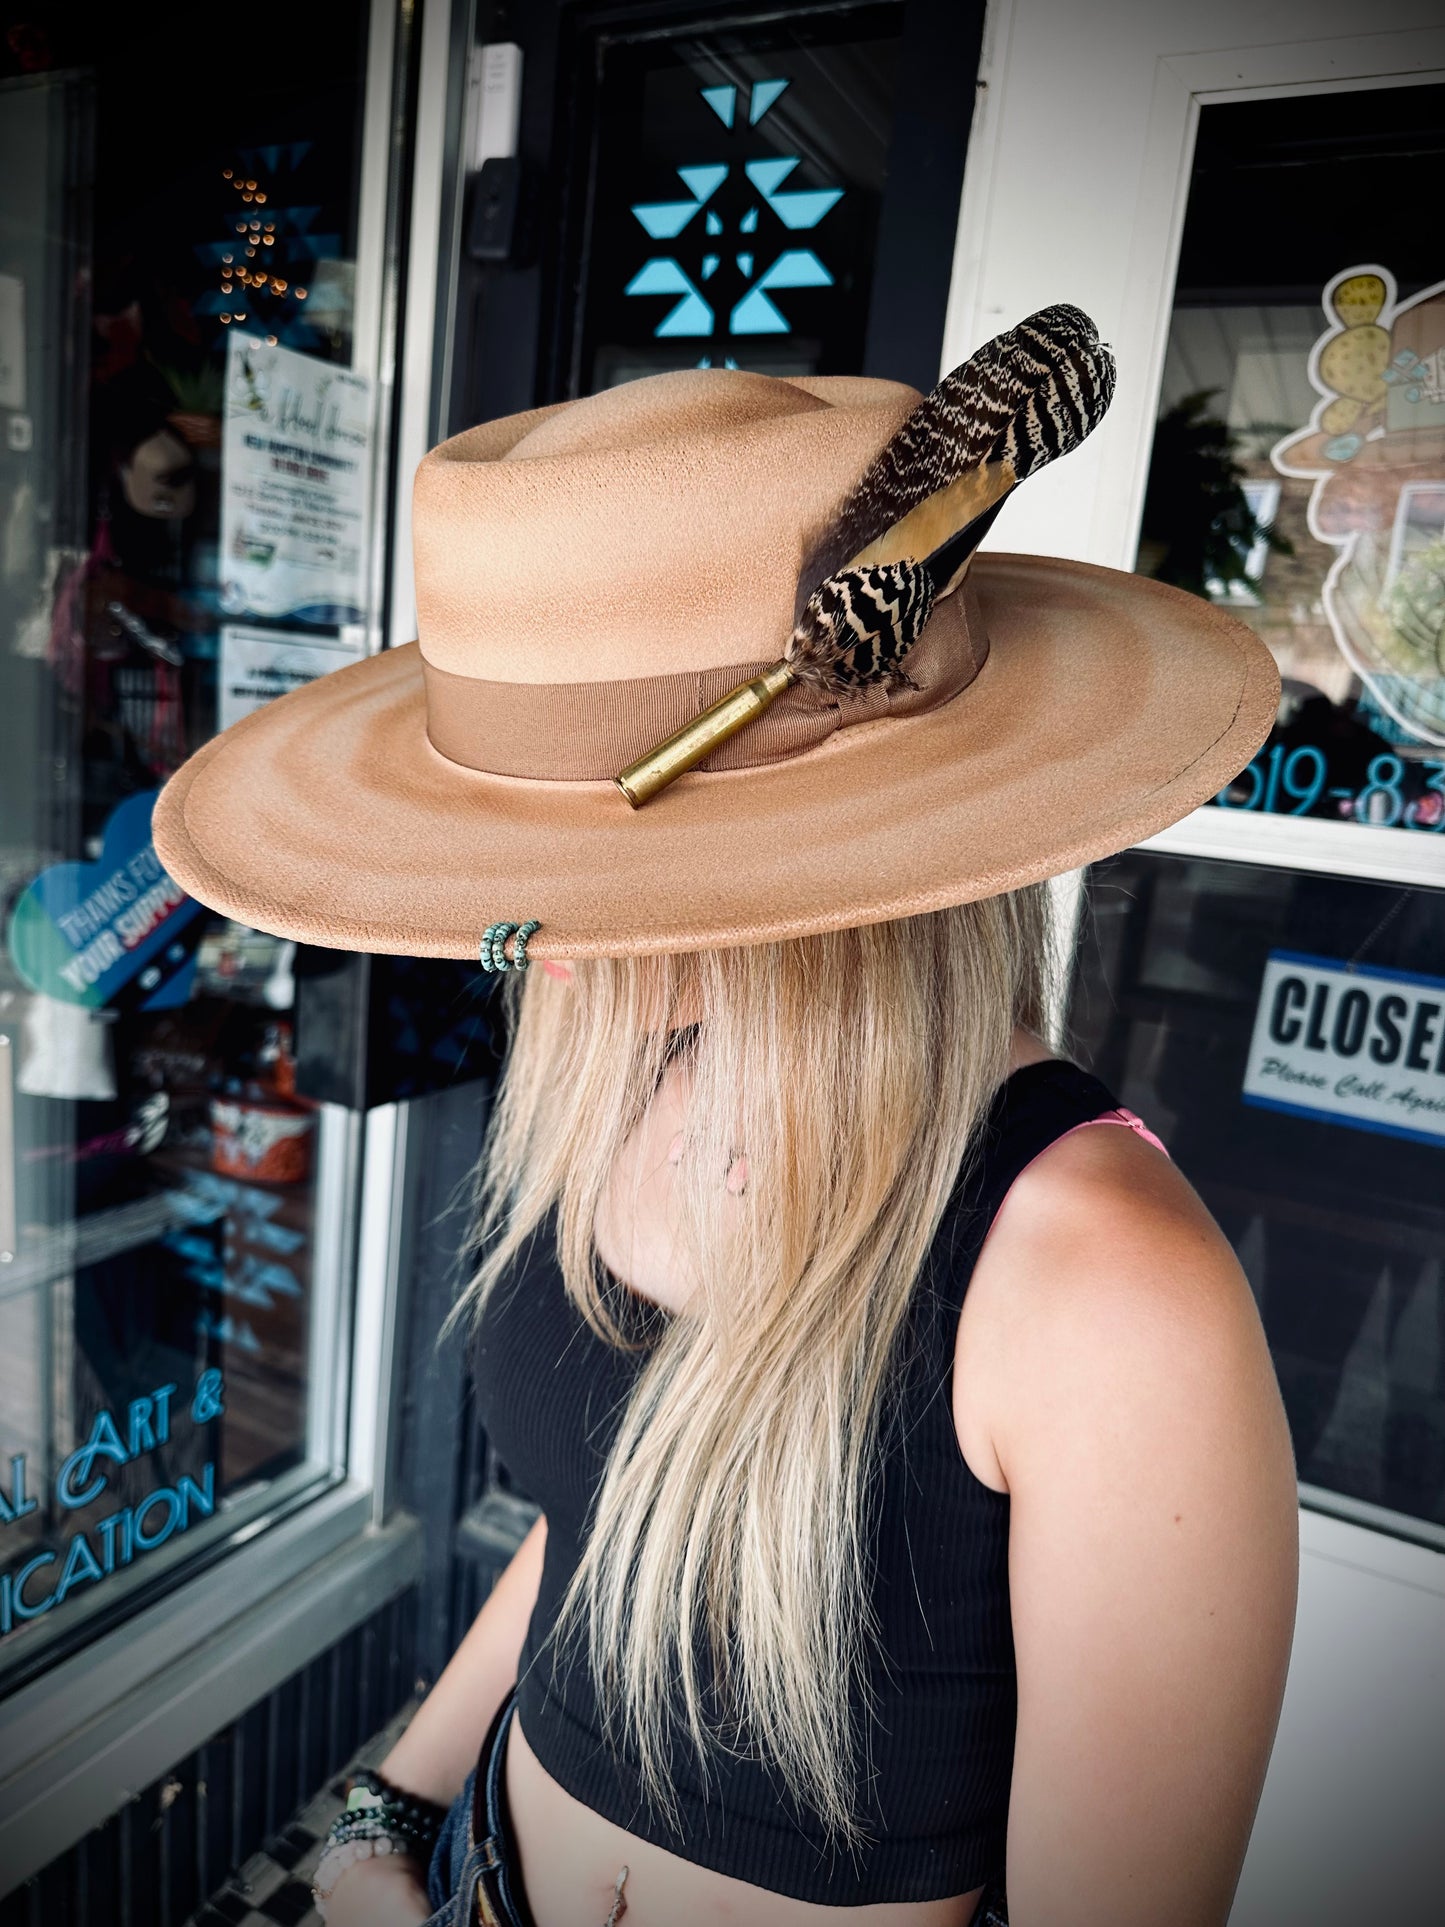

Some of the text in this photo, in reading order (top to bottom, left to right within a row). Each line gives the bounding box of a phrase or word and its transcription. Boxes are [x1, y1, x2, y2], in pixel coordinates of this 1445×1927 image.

[58, 871, 137, 948] THANKS
[60, 930, 125, 992] YOUR
[1270, 976, 1445, 1075] CLOSE
[1260, 1056, 1327, 1089] Please
[1333, 1074, 1387, 1099] Call
[192, 1368, 223, 1422] &
[0, 1462, 215, 1633] ICATION
